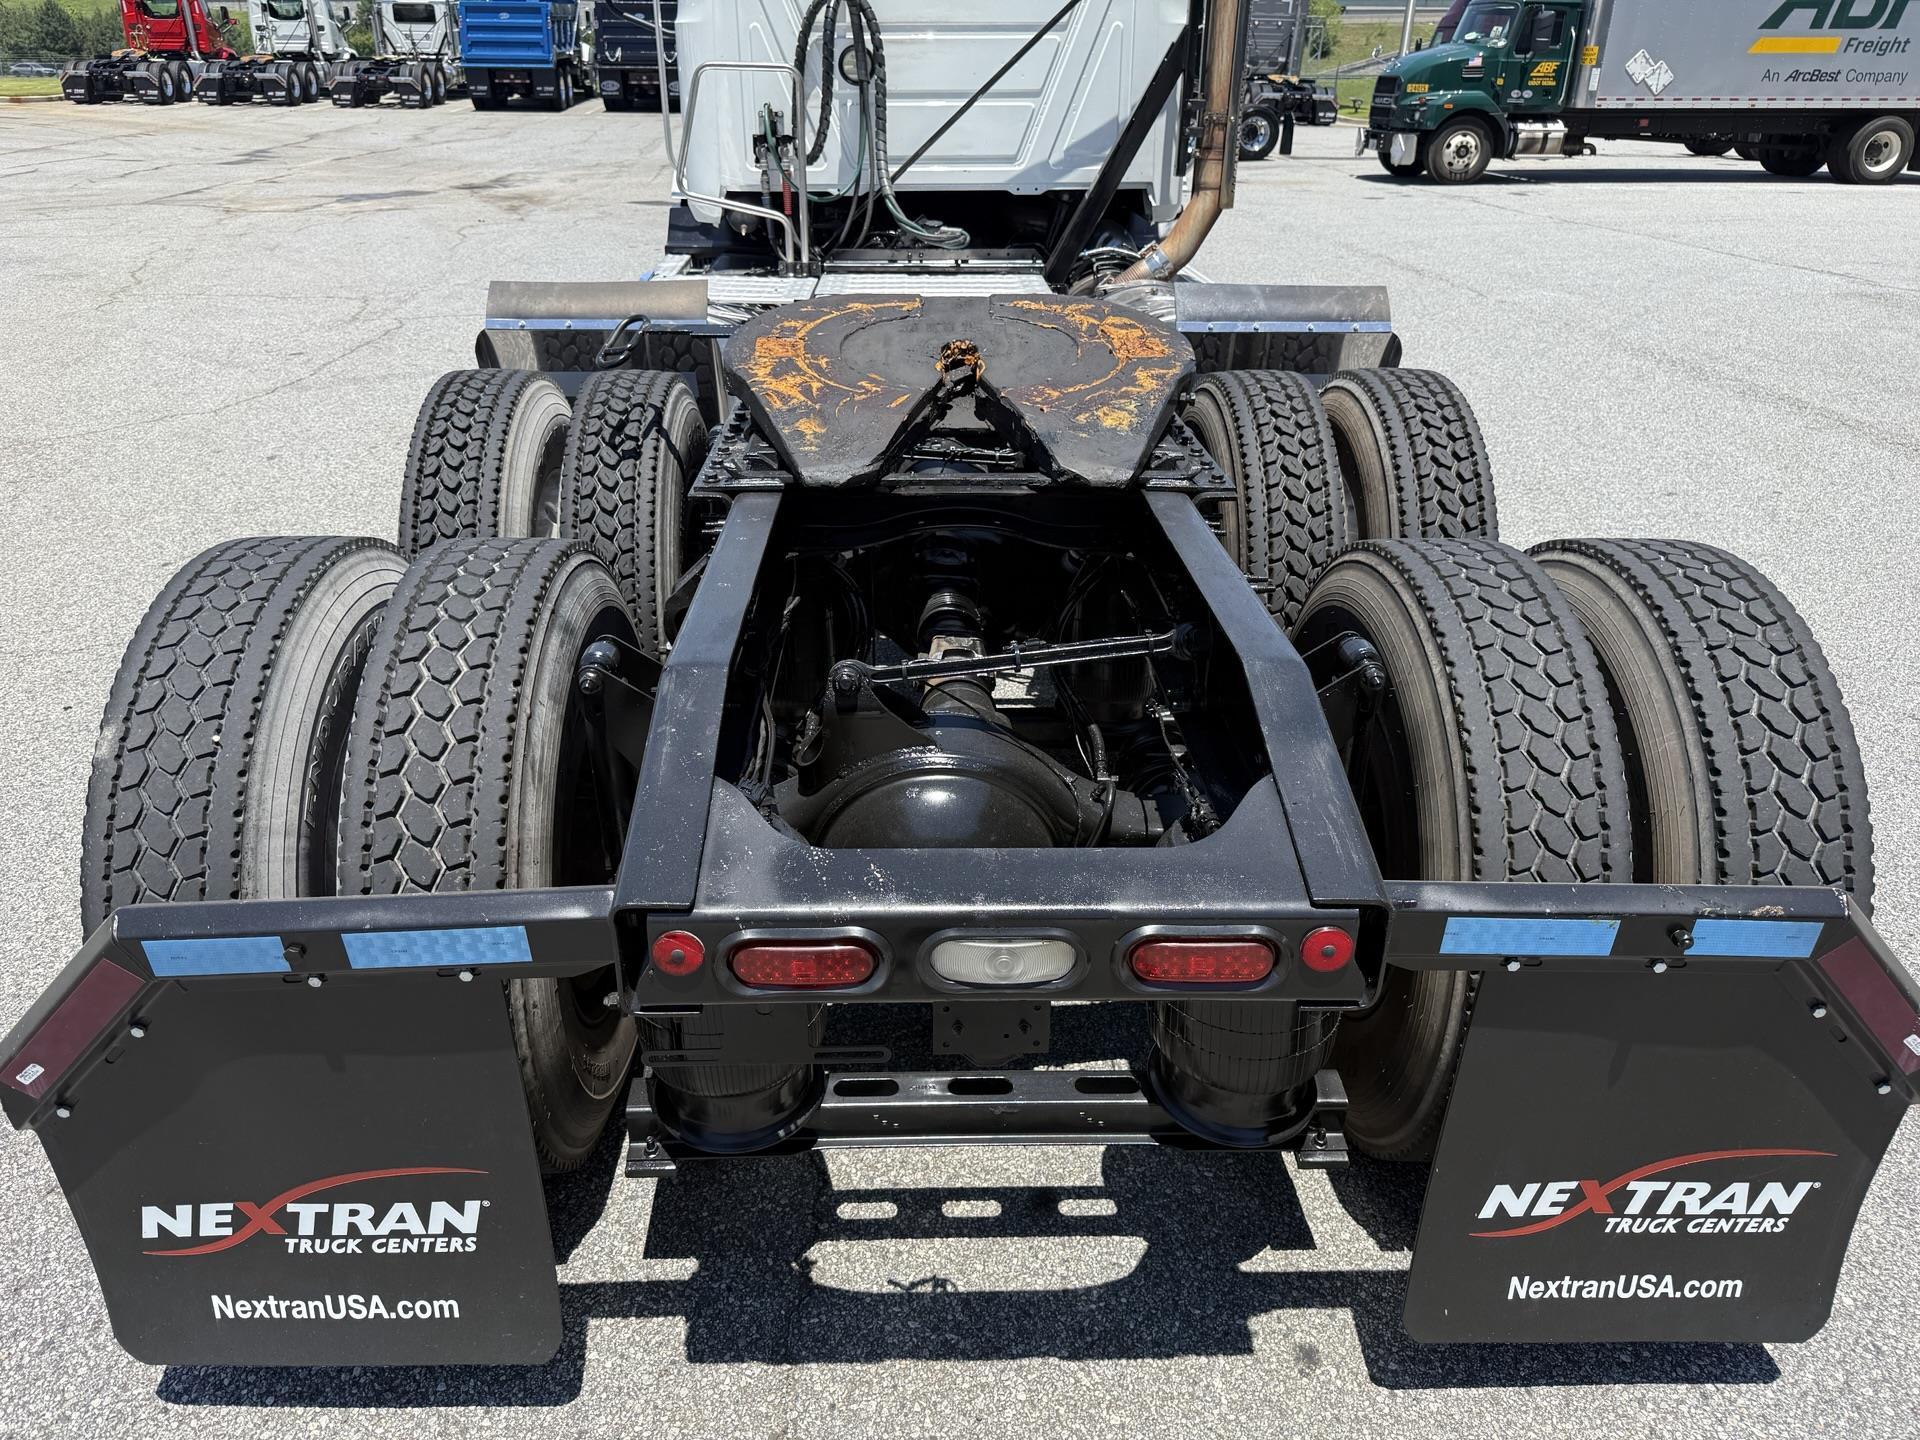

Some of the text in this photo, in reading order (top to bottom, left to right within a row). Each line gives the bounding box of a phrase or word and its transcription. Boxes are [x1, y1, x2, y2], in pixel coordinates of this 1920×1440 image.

[1843, 36, 1911, 56] Freight
[1533, 62, 1560, 73] ABF
[1761, 69, 1909, 85] An ArcBest Company
[1604, 1216, 1790, 1234] TRUCK CENTERS
[284, 1236, 477, 1254] TRUCK CENTERS
[1507, 1273, 1744, 1300] NextranUSA.com
[210, 1294, 460, 1320] NextranUSA.com
